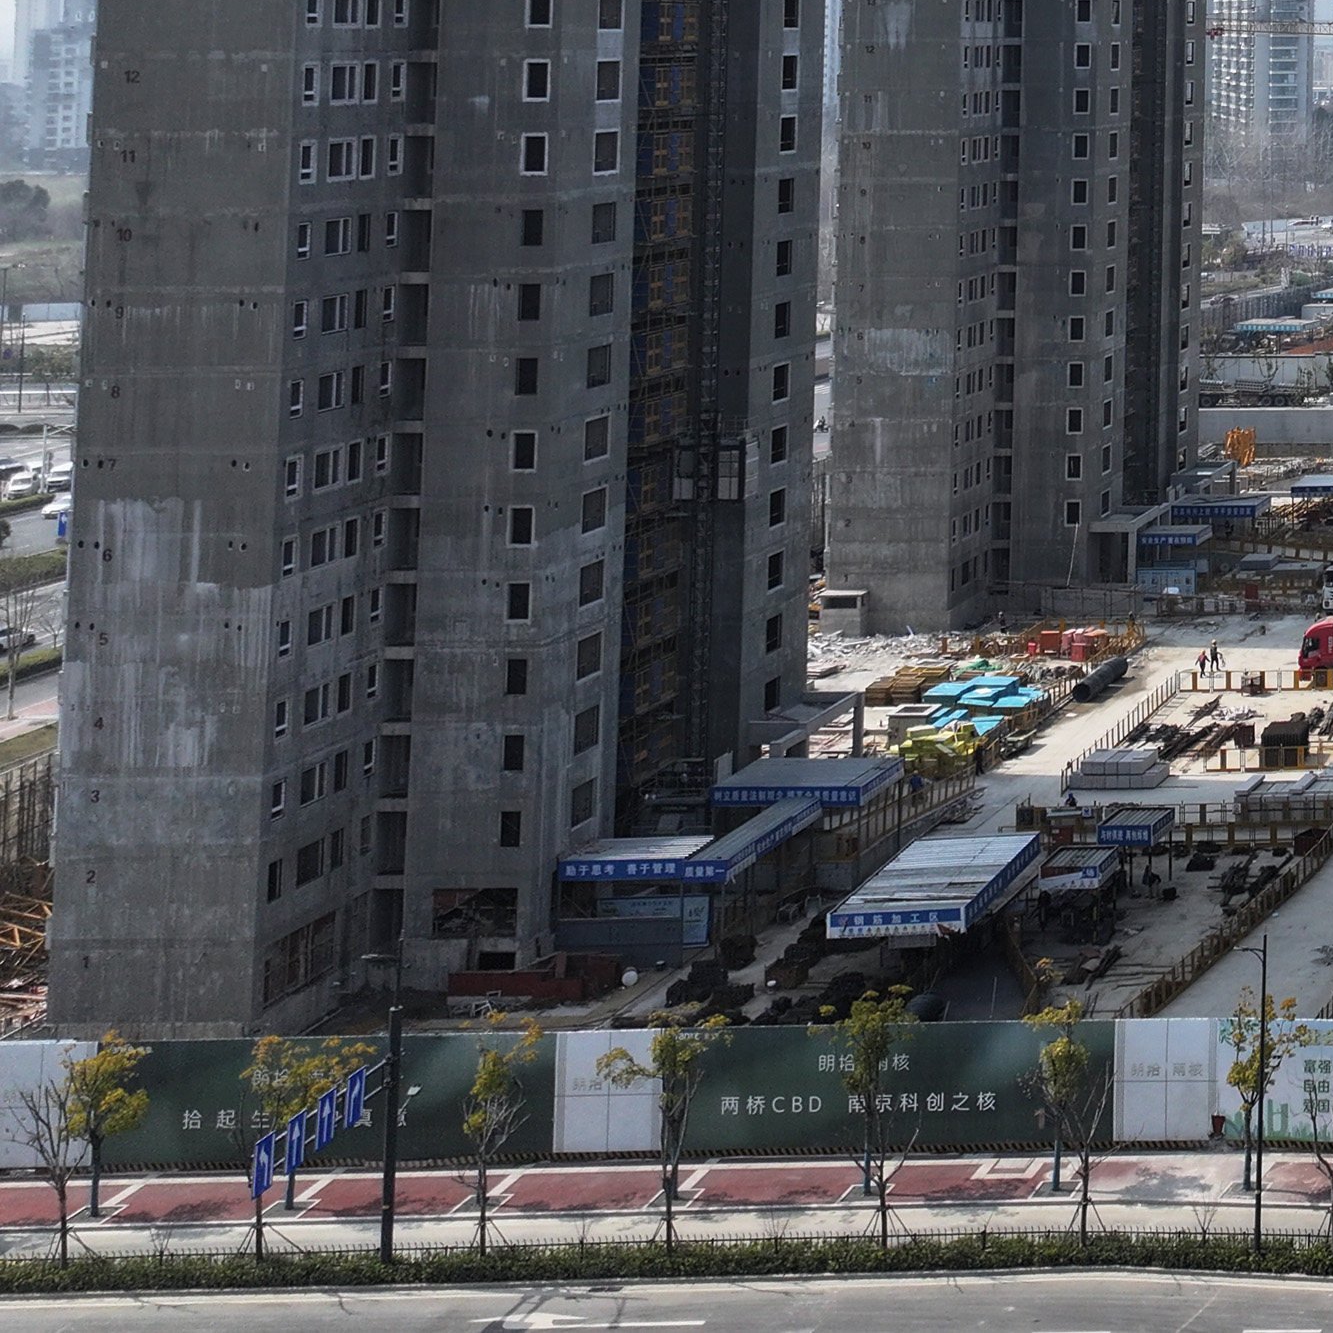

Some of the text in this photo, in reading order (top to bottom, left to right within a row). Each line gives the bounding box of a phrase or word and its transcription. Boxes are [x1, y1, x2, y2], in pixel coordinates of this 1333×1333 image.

[125, 71, 141, 84] 12
[121, 150, 137, 164] 11
[116, 229, 133, 242] 10
[115, 306, 124, 320] 9
[111, 386, 121, 399] 8
[108, 459, 117, 472] 7
[103, 549, 113, 562] 6
[99, 634, 109, 646] 5
[94, 718, 105, 731] 4
[91, 790, 101, 803] 3
[86, 871, 96, 884] 2
[853, 911, 938, 926] 钢筋加工区
[83, 956, 90, 969] 1
[1303, 1059, 1332, 1074] 富强
[1303, 1079, 1331, 1094] 自由
[720, 1091, 997, 1116] 两桥CBD 南京科创之核
